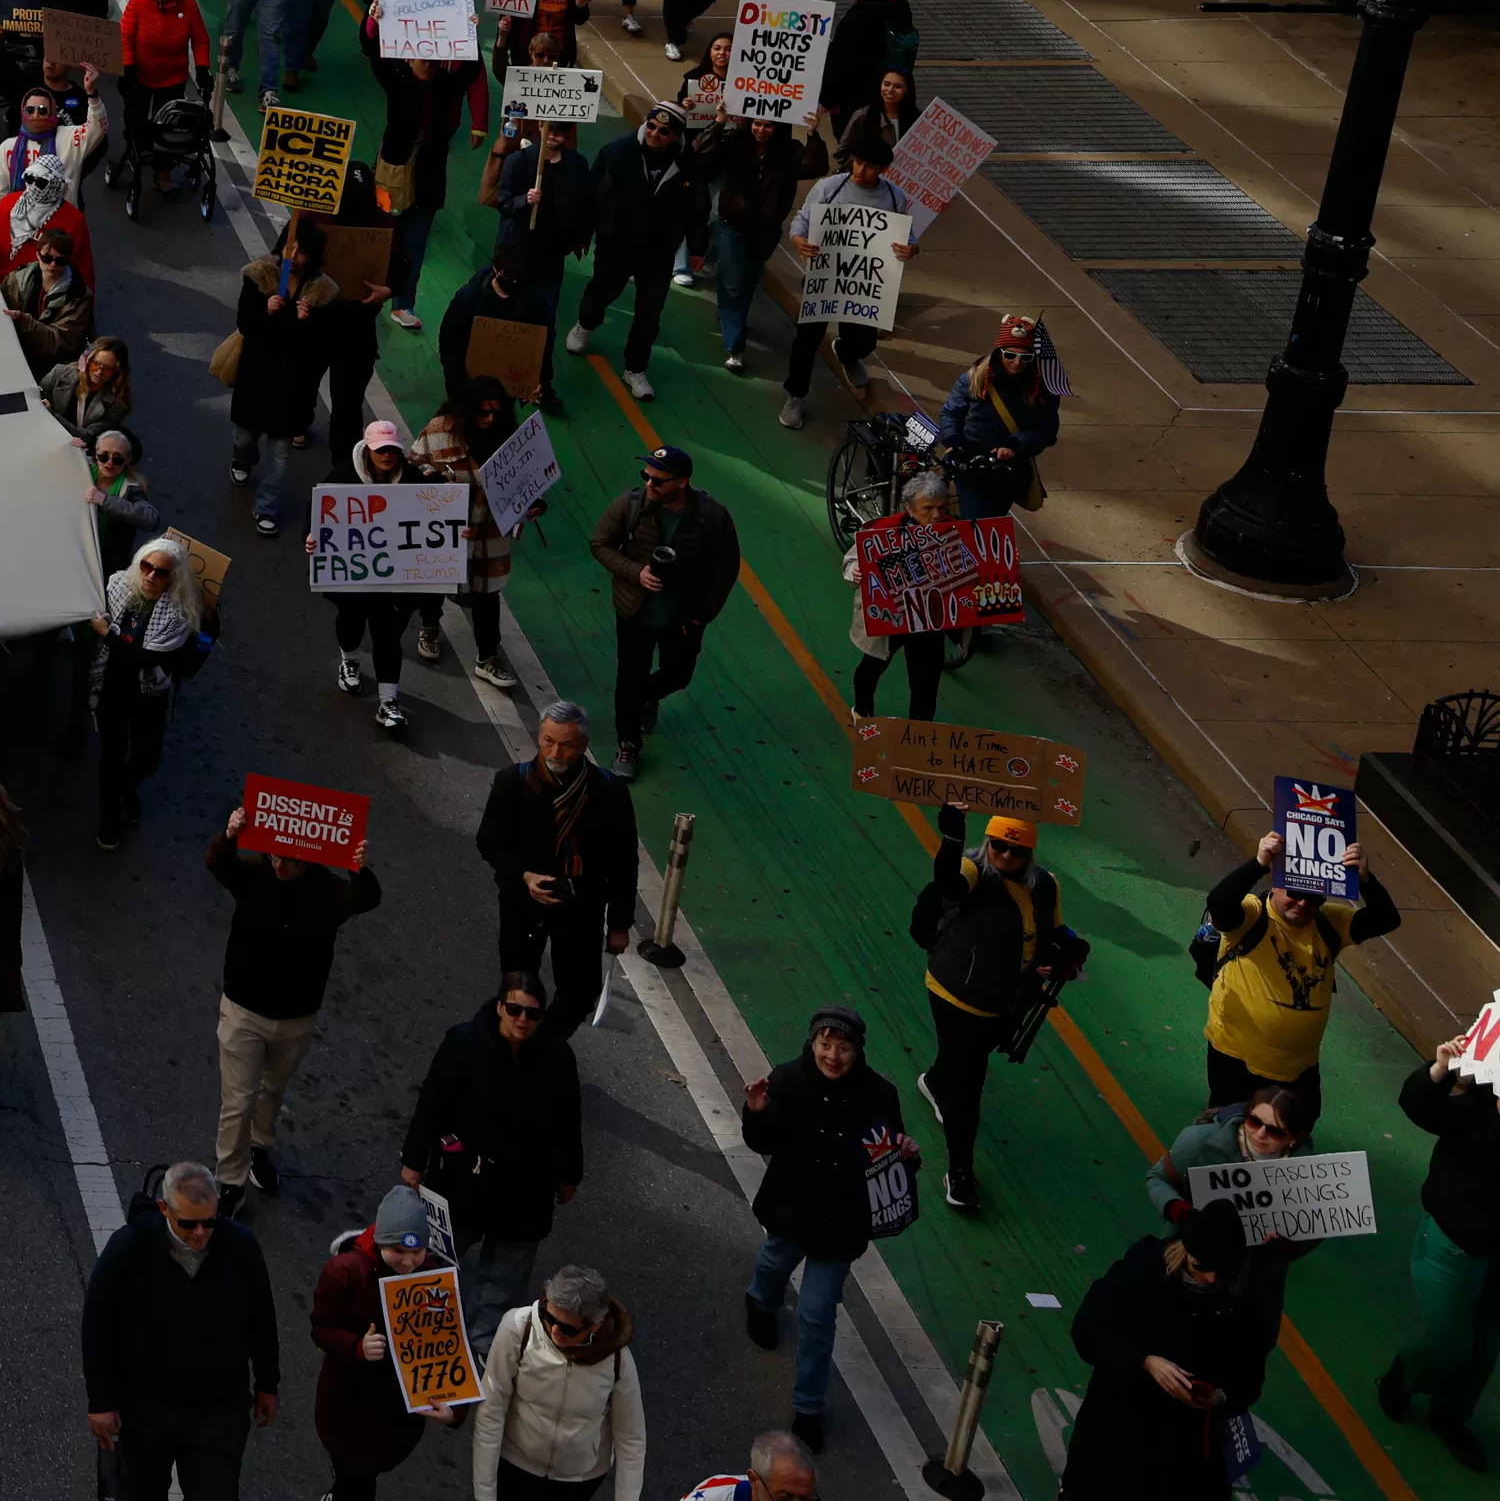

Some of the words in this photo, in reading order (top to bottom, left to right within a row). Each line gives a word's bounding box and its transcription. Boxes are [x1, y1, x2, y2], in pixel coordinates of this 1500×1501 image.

[751, 29, 812, 52] HURTS
[741, 49, 766, 64] NO
[534, 73, 566, 85] HATE
[753, 65, 791, 83] YOU
[521, 87, 582, 100] ILLINOIS
[735, 77, 804, 100] ORANGE
[266, 112, 350, 140] ABOLISH
[263, 129, 346, 166] ICE
[259, 167, 339, 192] AHORA
[261, 156, 340, 181] AHORA
[256, 179, 336, 203] AHORA
[820, 207, 888, 231] ALWAYS
[821, 229, 876, 249] MONEY
[810, 254, 830, 271] FOR
[836, 253, 884, 284] WAR
[806, 278, 828, 294] BUT
[834, 279, 882, 300] NONE
[801, 301, 816, 318] FOR
[821, 300, 838, 314] THE
[844, 301, 880, 321] POOR
[256, 791, 334, 823] DISSENT
[338, 807, 354, 825] is
[1286, 811, 1323, 824] CHICAGO
[1325, 817, 1345, 828] SAYS
[254, 811, 351, 845] PATRIOTIC
[275, 834, 294, 845] ACLU
[295, 838, 322, 850] Illinois
[1286, 821, 1347, 864] NO
[1285, 857, 1346, 881] KINGS
[1209, 1168, 1251, 1190] NO
[1263, 1162, 1352, 1186] FASCISTS
[1233, 1190, 1273, 1211] NO
[1282, 1183, 1349, 1205] KINGS
[1329, 1205, 1373, 1233] RING
[393, 1282, 434, 1311] No
[393, 1308, 459, 1337] Kings
[400, 1332, 461, 1366] Since
[411, 1356, 467, 1395] 1776
